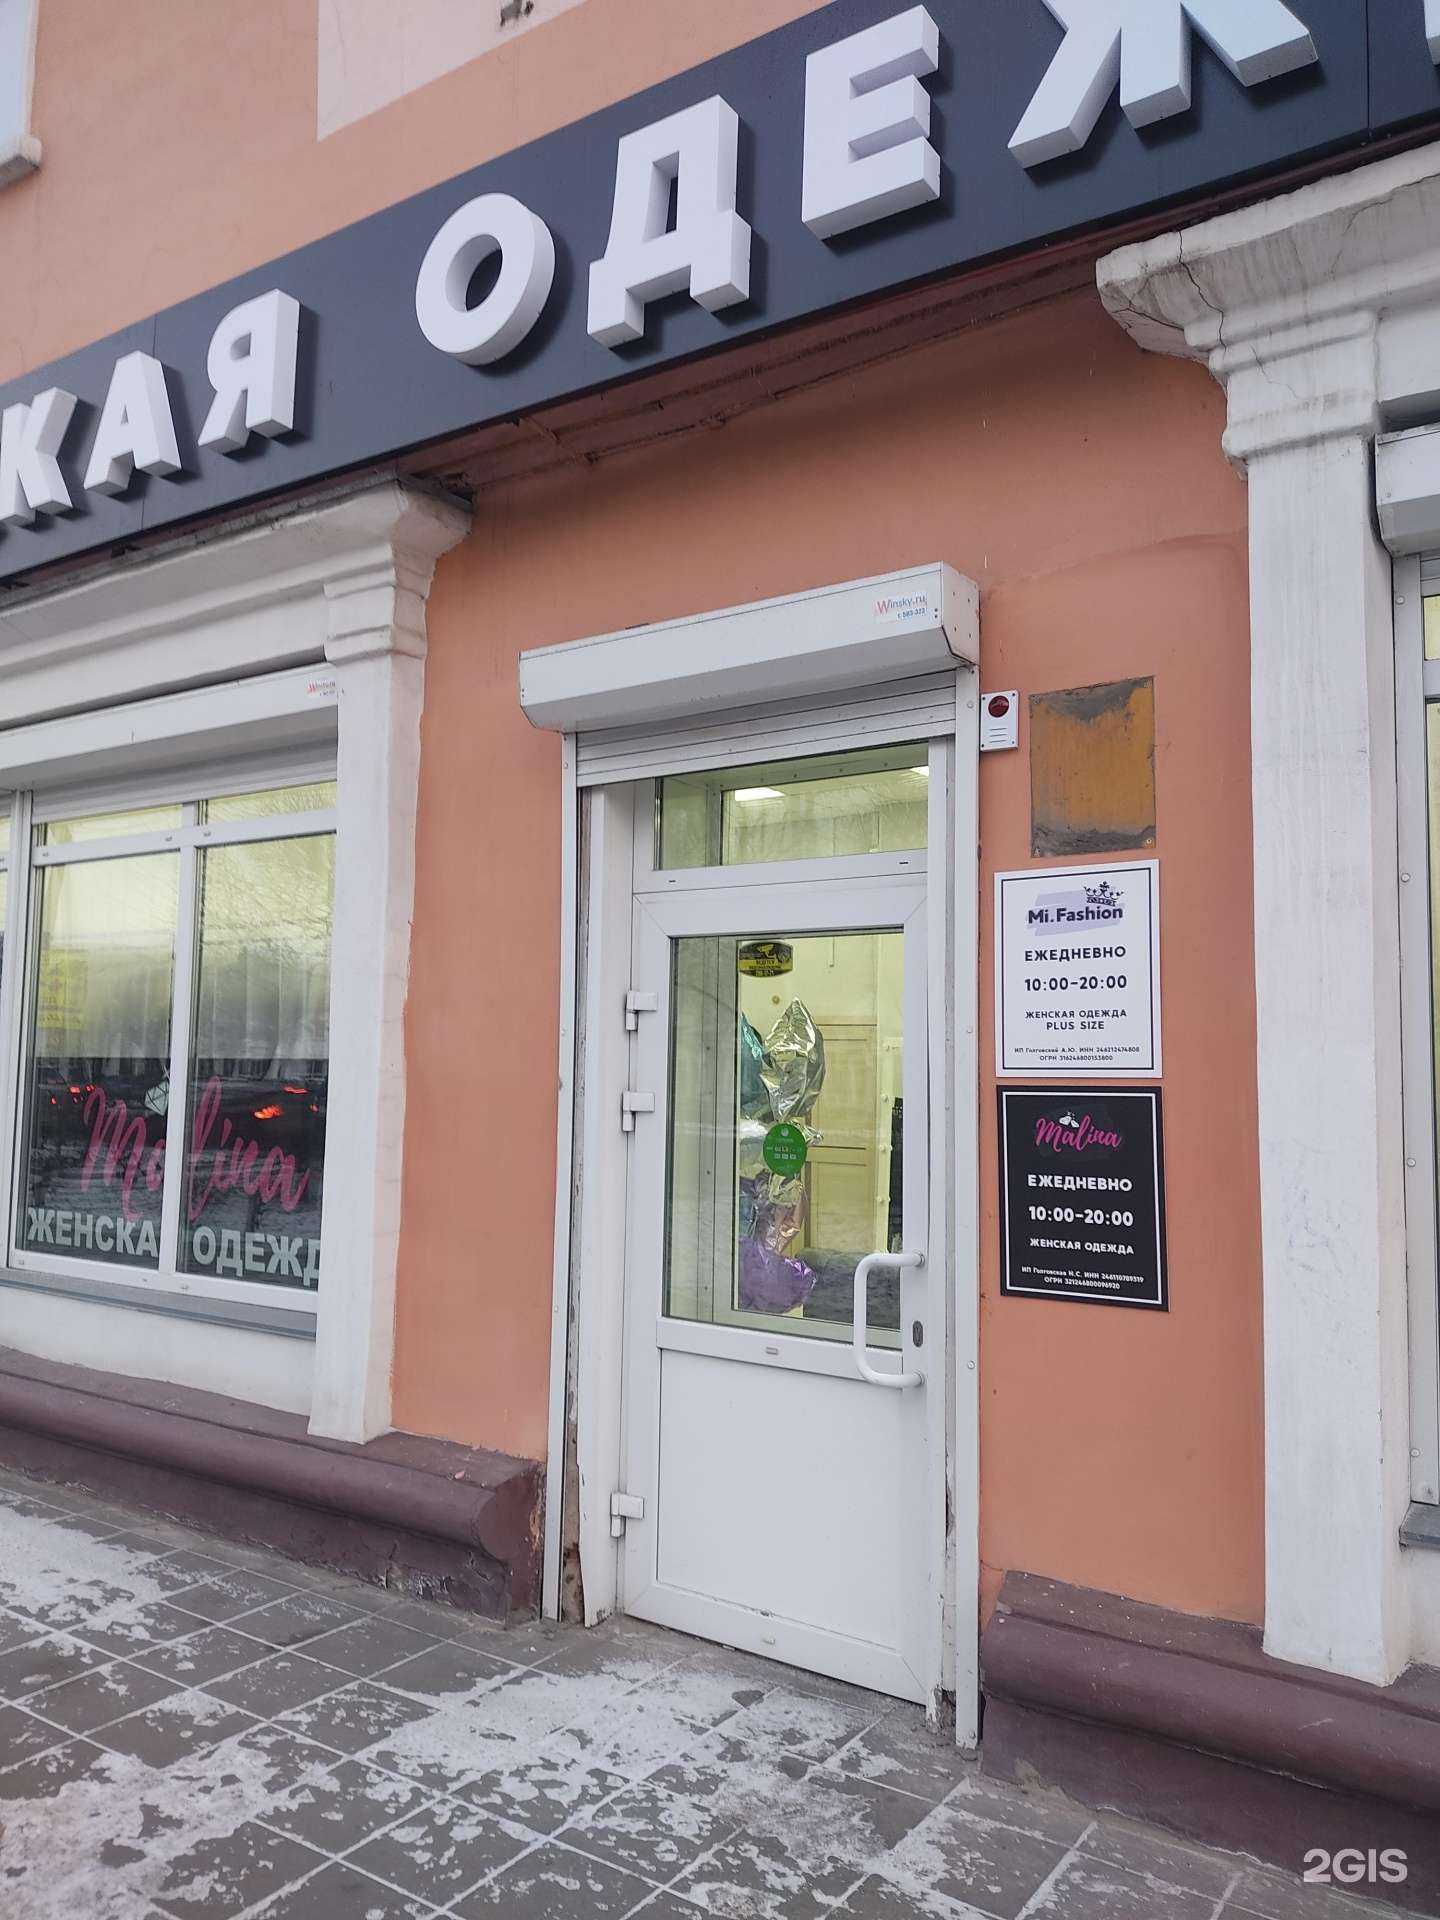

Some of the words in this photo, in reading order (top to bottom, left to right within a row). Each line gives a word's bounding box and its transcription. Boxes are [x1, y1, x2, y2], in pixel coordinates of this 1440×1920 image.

[0, 288, 300, 527] КАЯ
[415, 0, 1440, 366] ОДЕЖ
[1028, 906, 1123, 924] Mi.Fashion
[1025, 946, 1126, 962] ЕЖЕДНЕВНО
[1024, 975, 1127, 991] 10:00-20:00
[1025, 1010, 1075, 1019] ЖЕНСКАЯ
[1079, 1009, 1127, 1018] ОДЕЖДА
[1046, 1021, 1075, 1030] PLUS
[1080, 1021, 1105, 1030] SIZE
[1036, 1113, 1122, 1152] Malina
[1027, 1174, 1133, 1191] ЕЖЕДНЕВНО
[1028, 1206, 1134, 1226] 10:00-20:00
[1029, 1238, 1081, 1250] ЖЕНСКАЯ
[1084, 1241, 1134, 1254] ОДЕЖДА
[1044, 1276, 1062, 1284] ОГРН
[1084, 1271, 1099, 1279] ИНН
